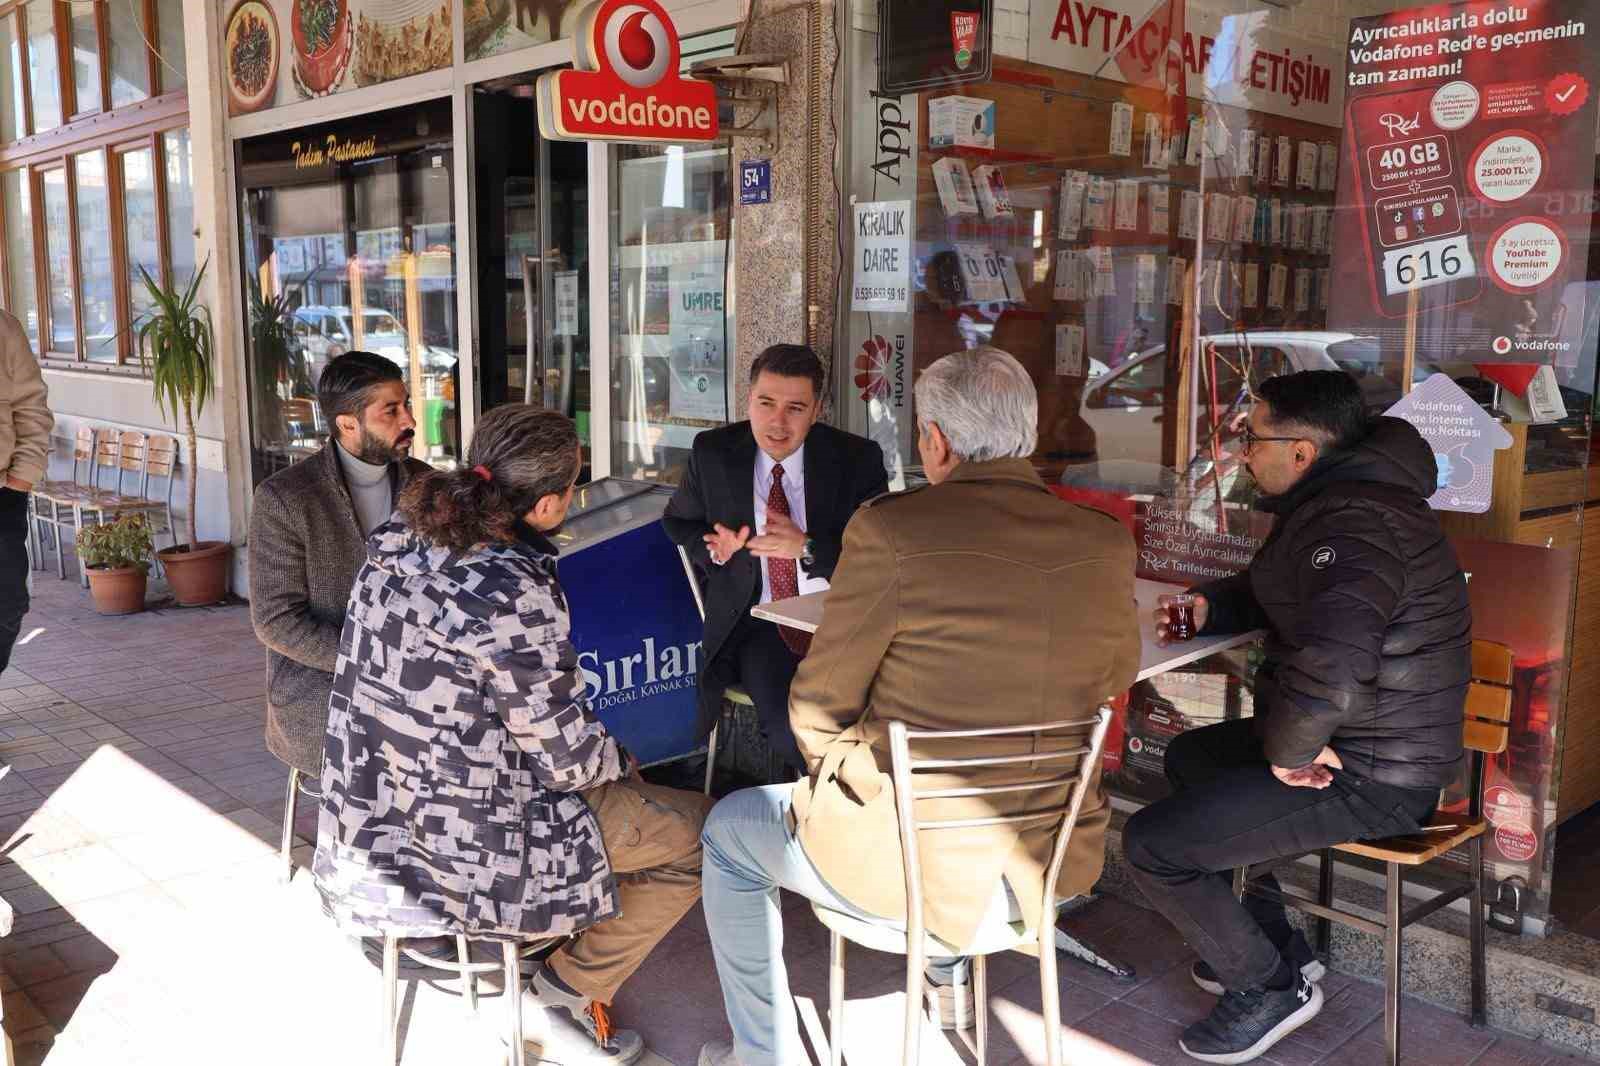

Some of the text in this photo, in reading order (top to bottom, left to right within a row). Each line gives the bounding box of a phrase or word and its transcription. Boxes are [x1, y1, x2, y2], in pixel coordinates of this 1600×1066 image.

[1351, 7, 1528, 45] Ayrıcalıklarla dolu
[1350, 20, 1585, 64] Vodafone Red'e geçmenin
[1348, 59, 1463, 86] tam zamanı!
[567, 93, 711, 130] vodafone
[1379, 112, 1420, 138] Red
[1380, 142, 1440, 169] 40 GB
[744, 168, 759, 188] 54
[1481, 167, 1512, 177] 25.000
[1397, 245, 1462, 285] 616
[1504, 260, 1549, 269] Premium
[1505, 249, 1547, 258] YouTube
[1514, 340, 1571, 351] vodafone
[894, 334, 905, 408] HUAWEI
[1411, 400, 1464, 412] Vodafone
[1143, 534, 1164, 549] Size
[600, 691, 639, 710] DOĞAL
[641, 680, 682, 697] KAYNAK
